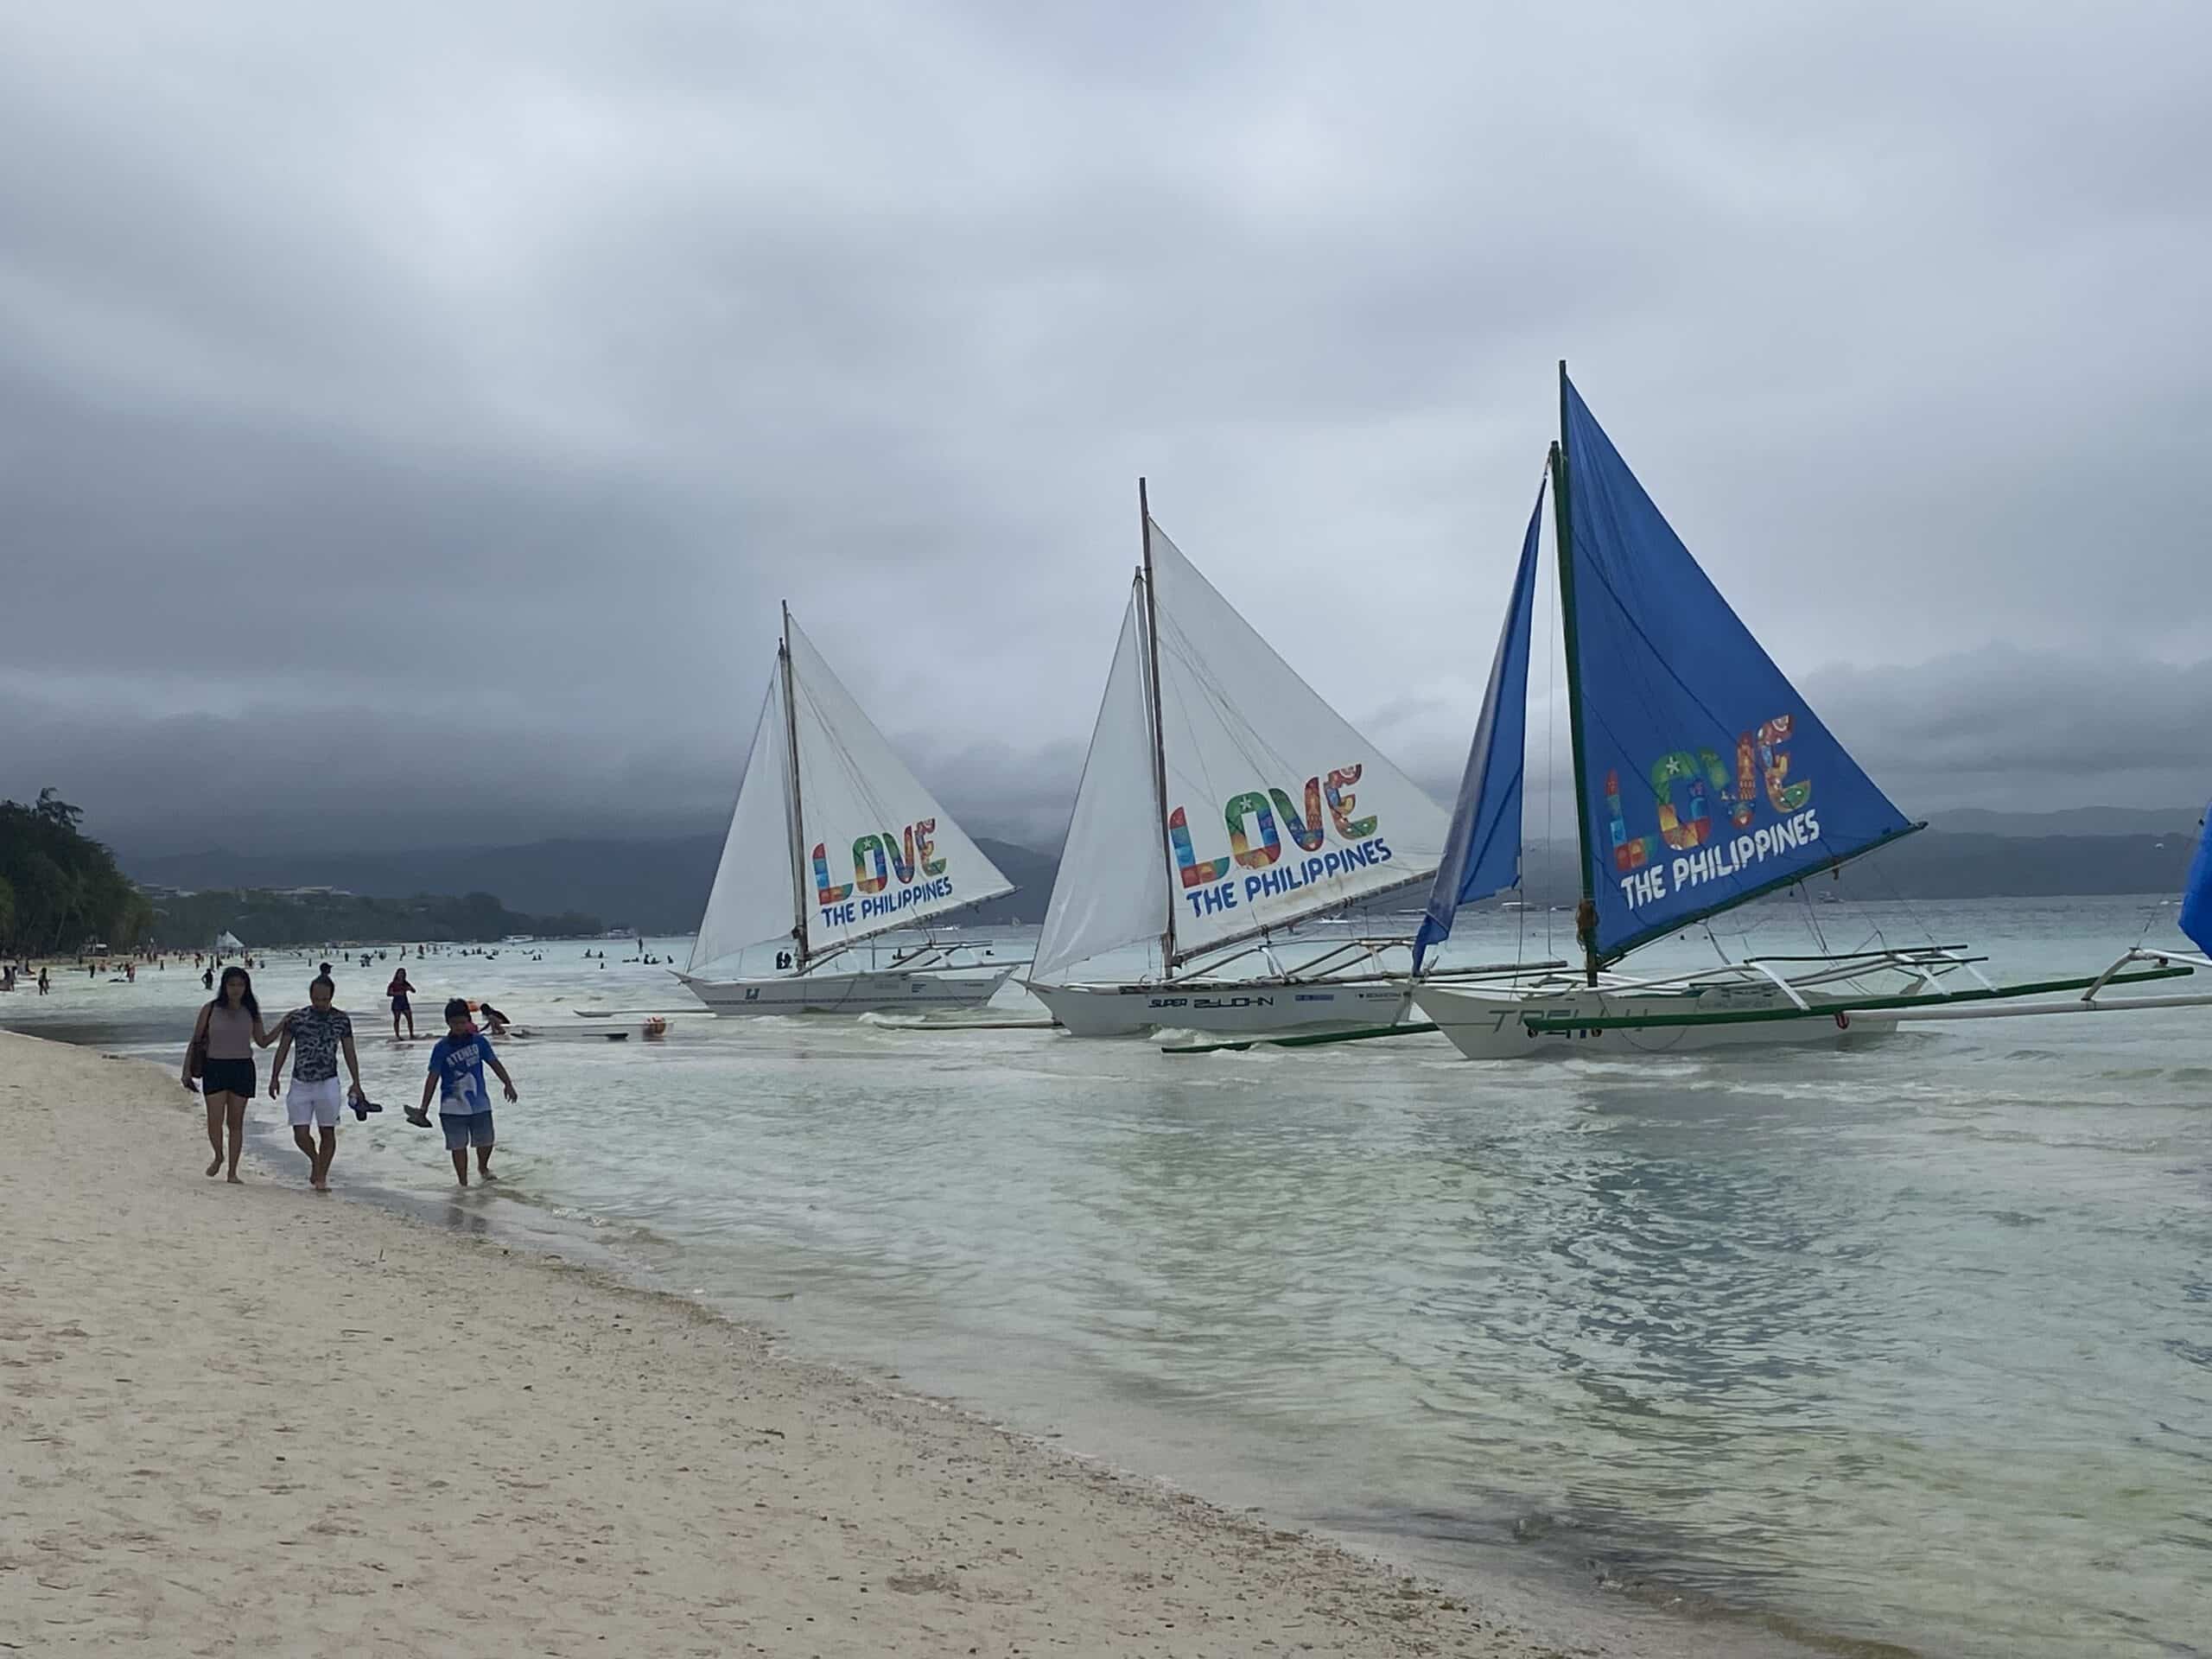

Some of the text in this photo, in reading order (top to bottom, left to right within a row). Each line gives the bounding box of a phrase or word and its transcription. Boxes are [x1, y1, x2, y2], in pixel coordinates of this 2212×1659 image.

[1169, 764, 1377, 888] LOVE
[1605, 714, 1811, 872] LOVE
[812, 818, 947, 906] LOVE
[821, 876, 952, 928] THE PHILIPPINES
[1186, 837, 1392, 918] THE PHILIPPINES
[1620, 809, 1820, 910] THE PHILIPPINES
